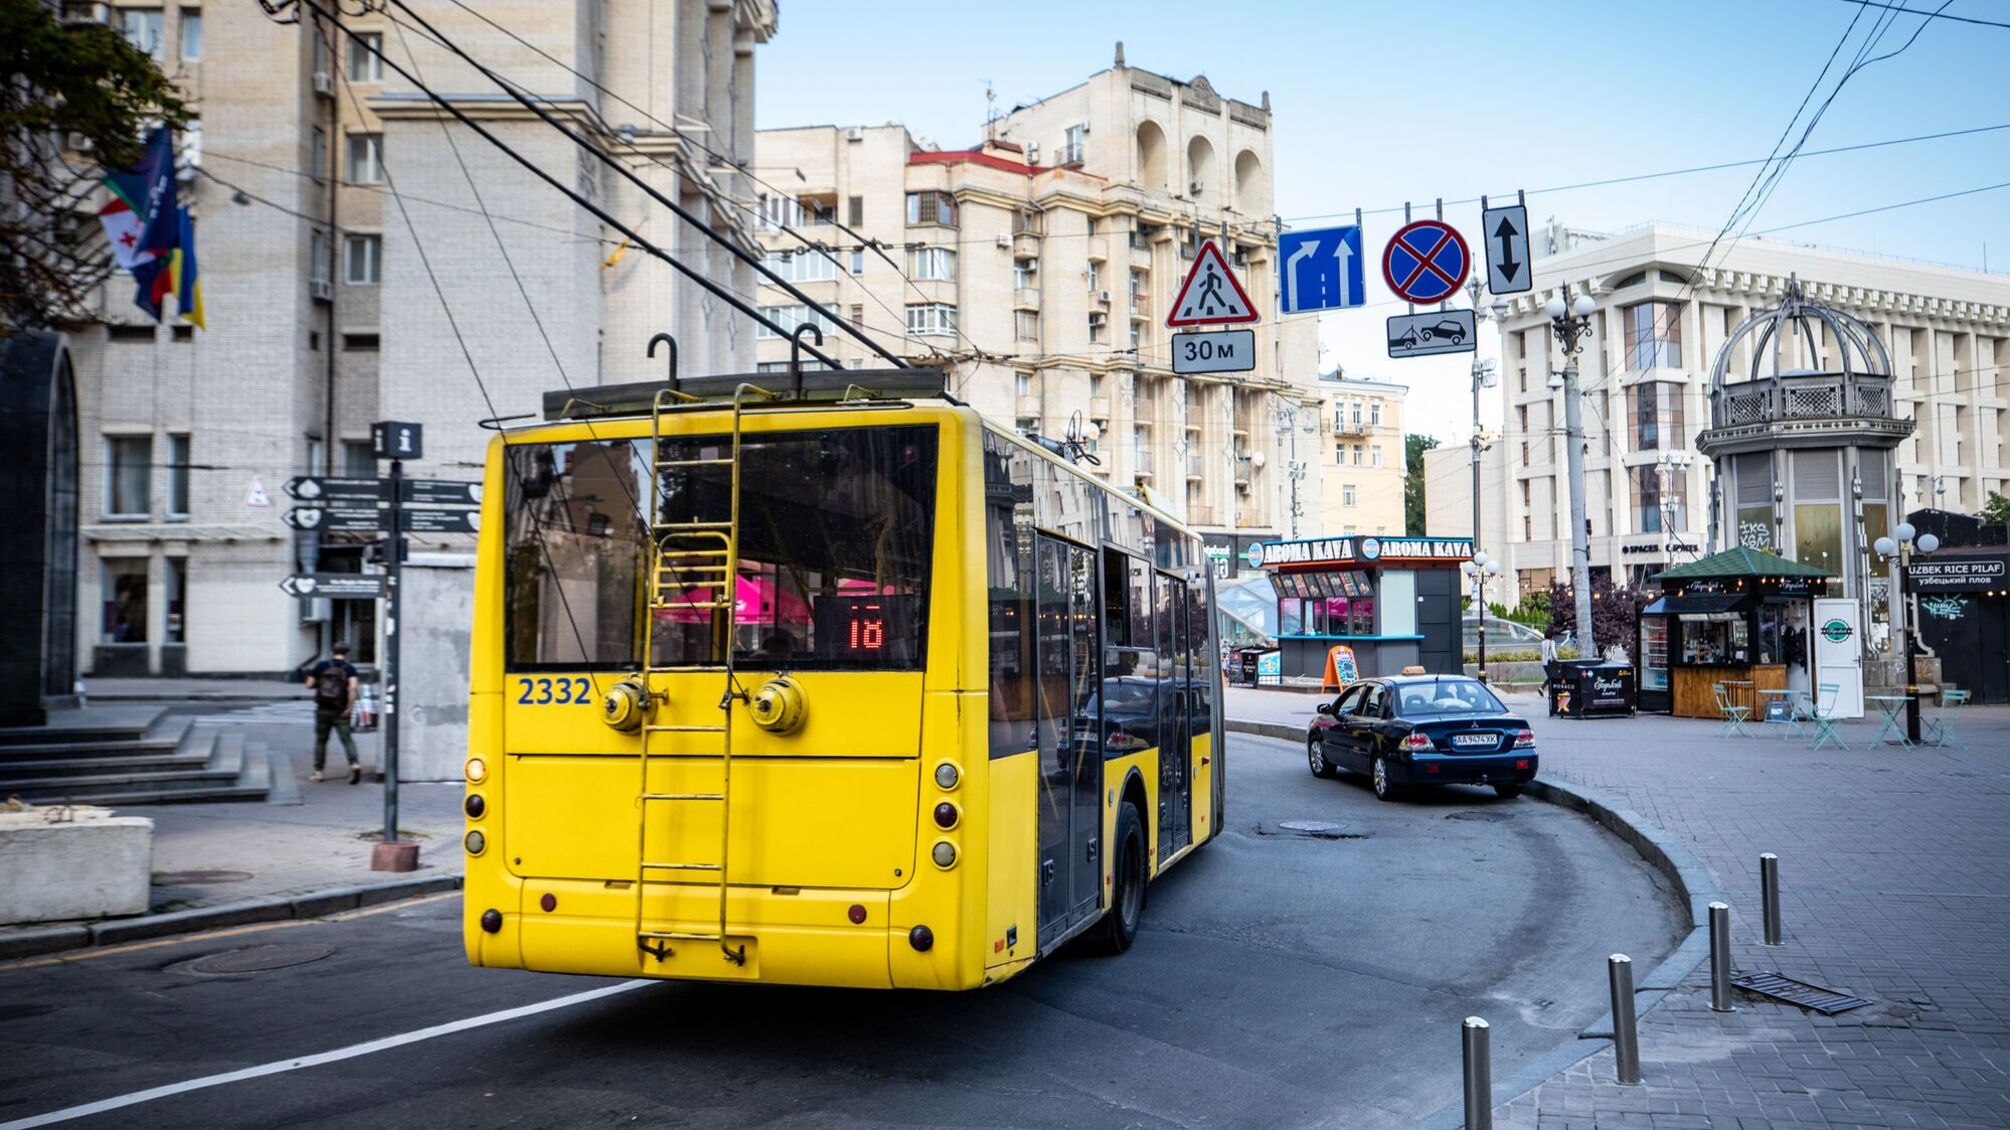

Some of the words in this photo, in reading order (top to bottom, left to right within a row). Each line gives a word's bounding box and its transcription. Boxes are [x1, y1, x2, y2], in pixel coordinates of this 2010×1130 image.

[1184, 340, 1213, 362] 30
[1264, 543, 1311, 563] AROMA
[1312, 539, 1353, 561] KAVA
[1380, 541, 1431, 557] AROMA
[1433, 541, 1472, 557] KAVA
[1908, 565, 1942, 575] UZBEK
[1944, 564, 1969, 574] RICE
[1971, 563, 2001, 573] PILAF
[1918, 575, 1967, 587] узбецький
[1968, 577, 1992, 585] плов
[517, 677, 592, 705] 2332
